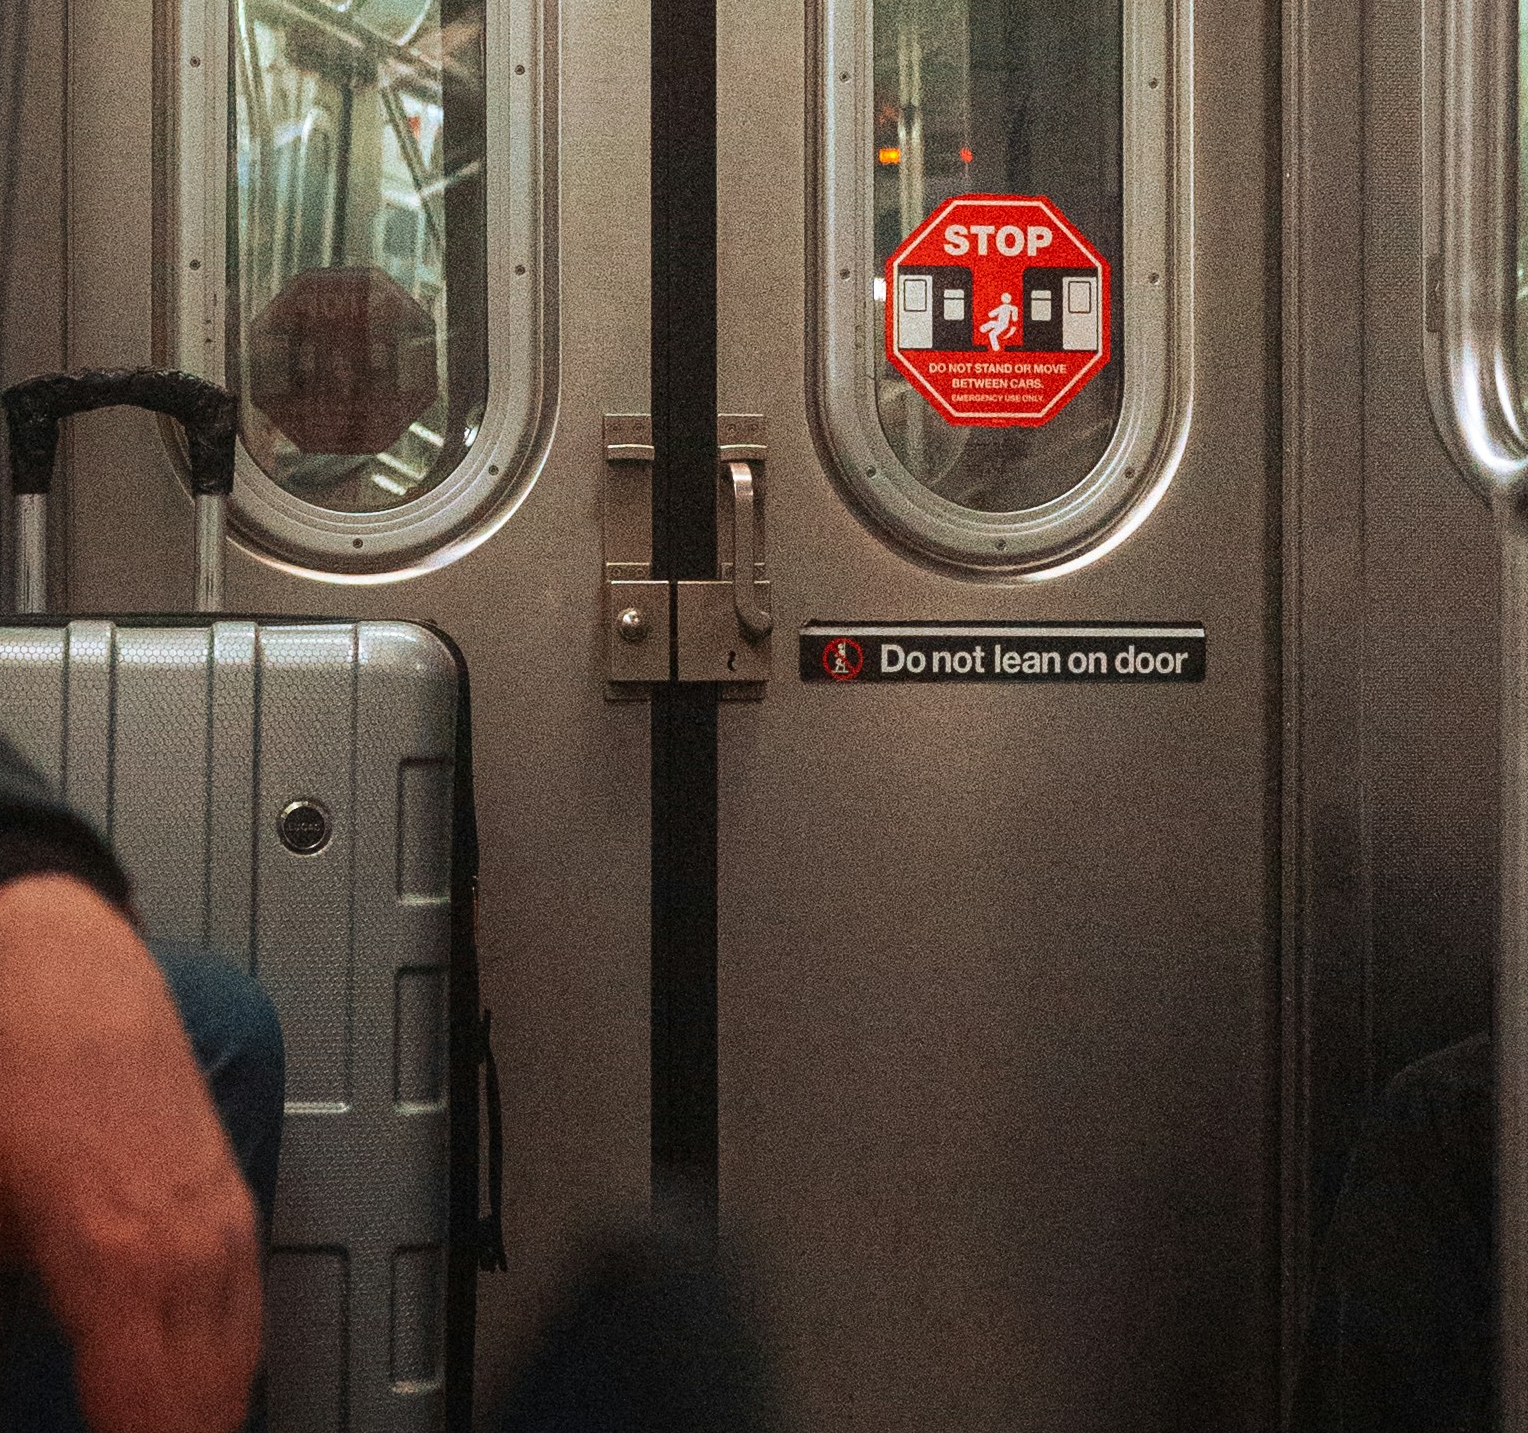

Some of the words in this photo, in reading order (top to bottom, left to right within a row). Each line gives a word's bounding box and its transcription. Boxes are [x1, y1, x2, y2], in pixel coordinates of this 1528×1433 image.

[943, 224, 1053, 257] STOP
[928, 363, 947, 374] DO
[948, 363, 972, 374] NOT
[974, 363, 1013, 374] STAND
[1014, 363, 1031, 374] OR
[1033, 364, 1068, 374] MOVE
[951, 378, 1008, 389] BETWEEN
[1009, 378, 1045, 390] CARS.
[951, 394, 1003, 403] EMERGENCY
[1004, 394, 1021, 403] USE
[879, 642, 926, 674] Do
[932, 644, 986, 674] not
[994, 644, 1062, 675] lean
[1068, 651, 1108, 675] on
[1114, 644, 1190, 675] door
